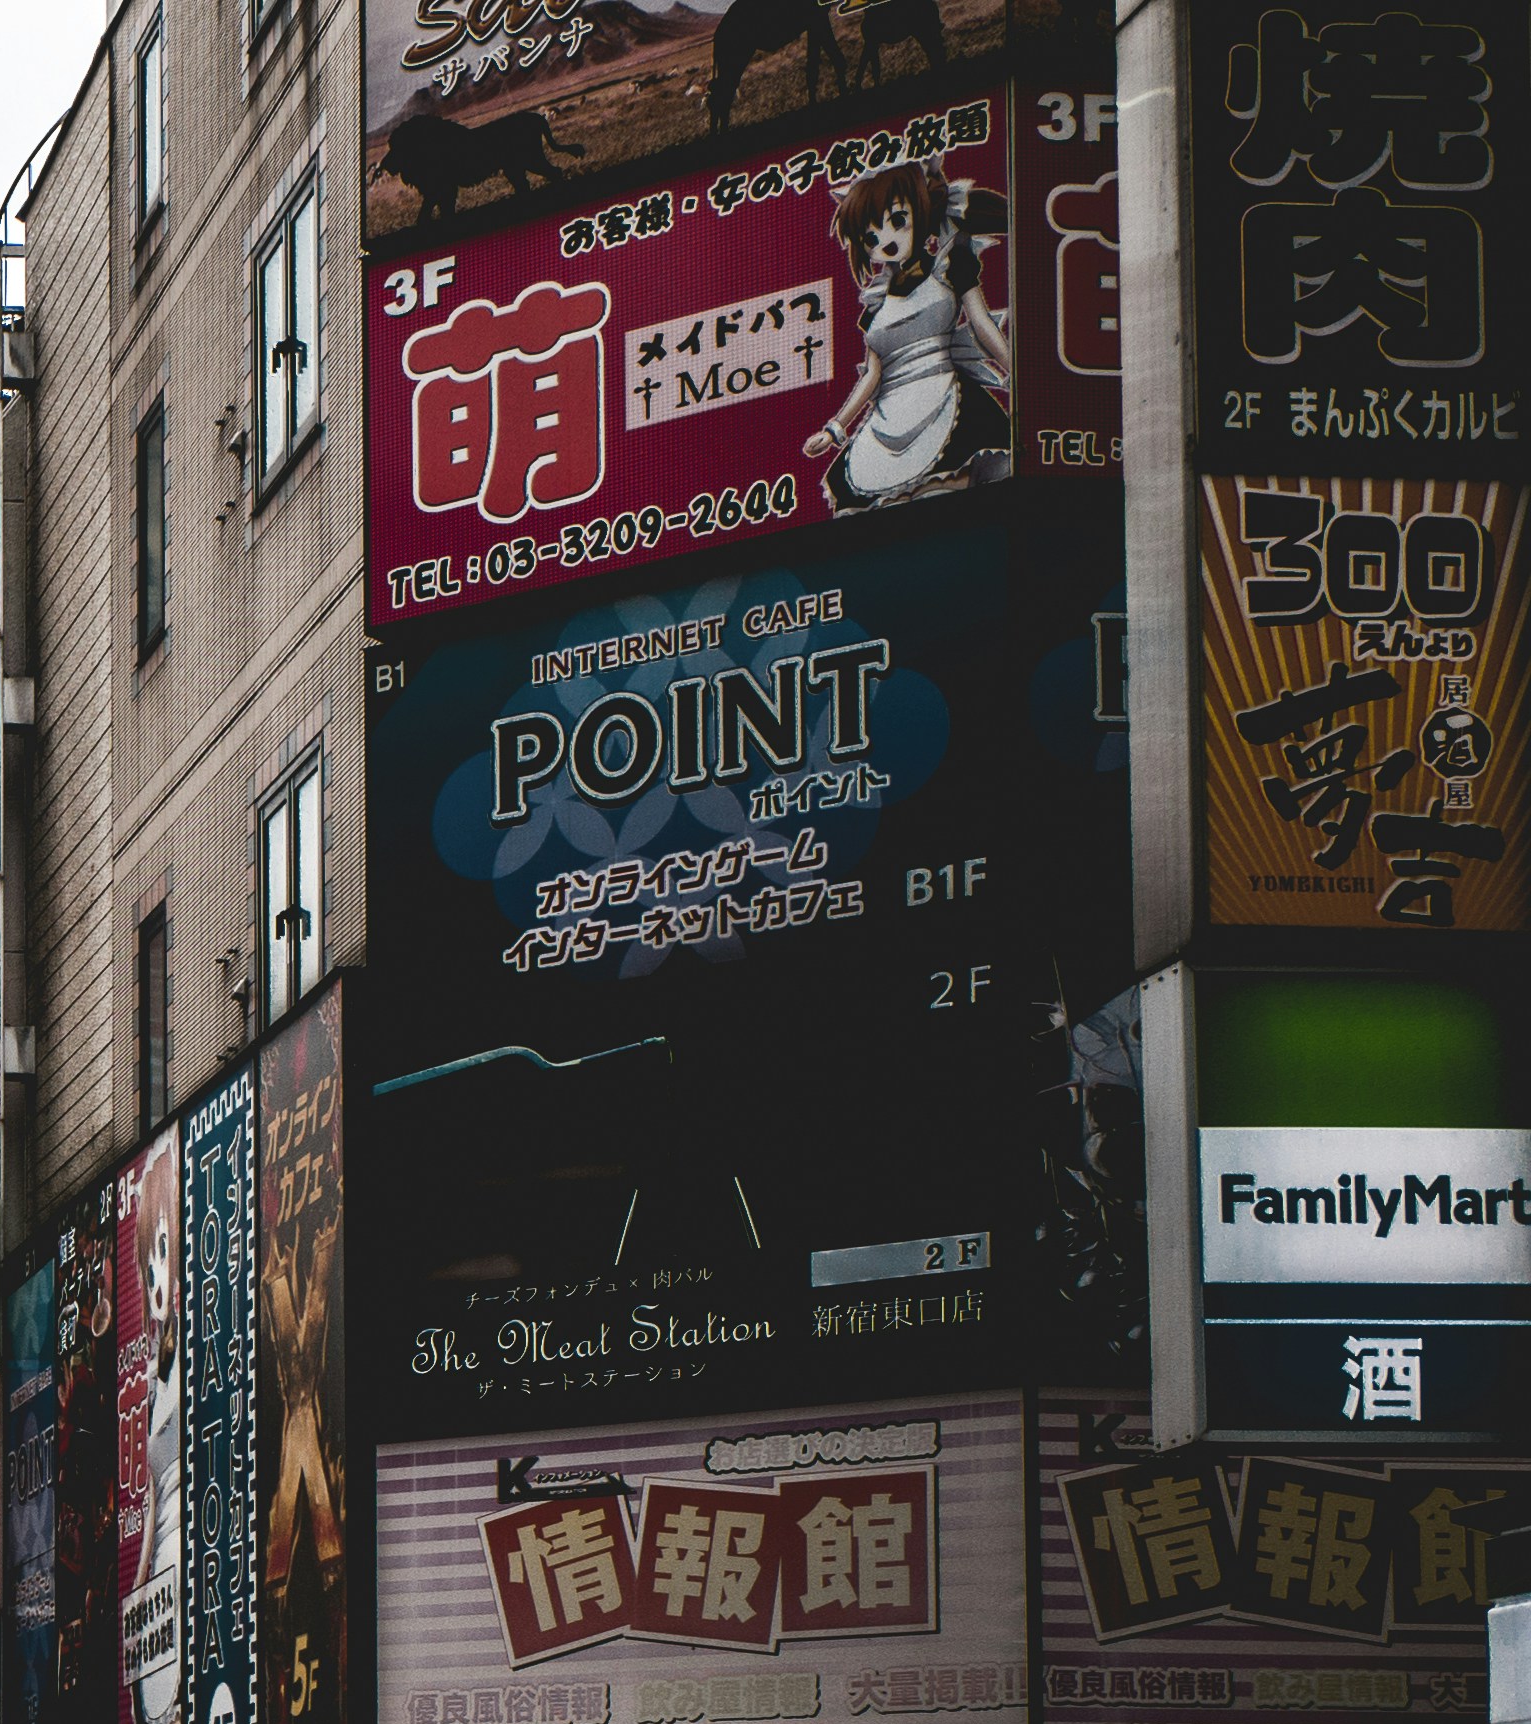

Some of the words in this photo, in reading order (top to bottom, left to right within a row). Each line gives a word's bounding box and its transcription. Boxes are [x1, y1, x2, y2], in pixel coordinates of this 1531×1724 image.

[434, 19, 594, 96] サバンナ
[1225, 8, 1495, 368] 焼肉
[382, 256, 457, 317] 3F
[636, 292, 827, 367] メイドパブ
[402, 281, 613, 525] 萌
[675, 357, 782, 408] Moe
[1224, 389, 1263, 432] 2F
[1241, 486, 1495, 627] 300
[531, 615, 726, 688] INTERNET
[741, 588, 845, 640] CAFE
[1355, 621, 1478, 662] えんより
[375, 660, 407, 695] B1
[488, 637, 891, 828] POINT
[747, 760, 893, 823] ポイント
[535, 827, 829, 919] オンラインゲーム
[904, 856, 990, 908] B1F
[502, 878, 865, 973] インターネットカフェ
[928, 964, 993, 1012] 2F
[117, 1169, 136, 1222] 3F
[1218, 1172, 1531, 1239] FamilyMart
[200, 1142, 224, 1402] TORA
[464, 1273, 622, 1311] チーズフォンデュ
[651, 1265, 715, 1291] 肉バル
[410, 1328, 482, 1376] The
[496, 1314, 613, 1368] Meat
[629, 1302, 778, 1355] Station
[809, 1290, 984, 1341] 新宿東口店
[476, 1359, 707, 1398] ザ・ミートステーション
[1342, 1334, 1424, 1423] 酒
[200, 1421, 226, 1673] TORA
[507, 1491, 914, 1634] 情報館
[290, 1634, 319, 1718] 5F
